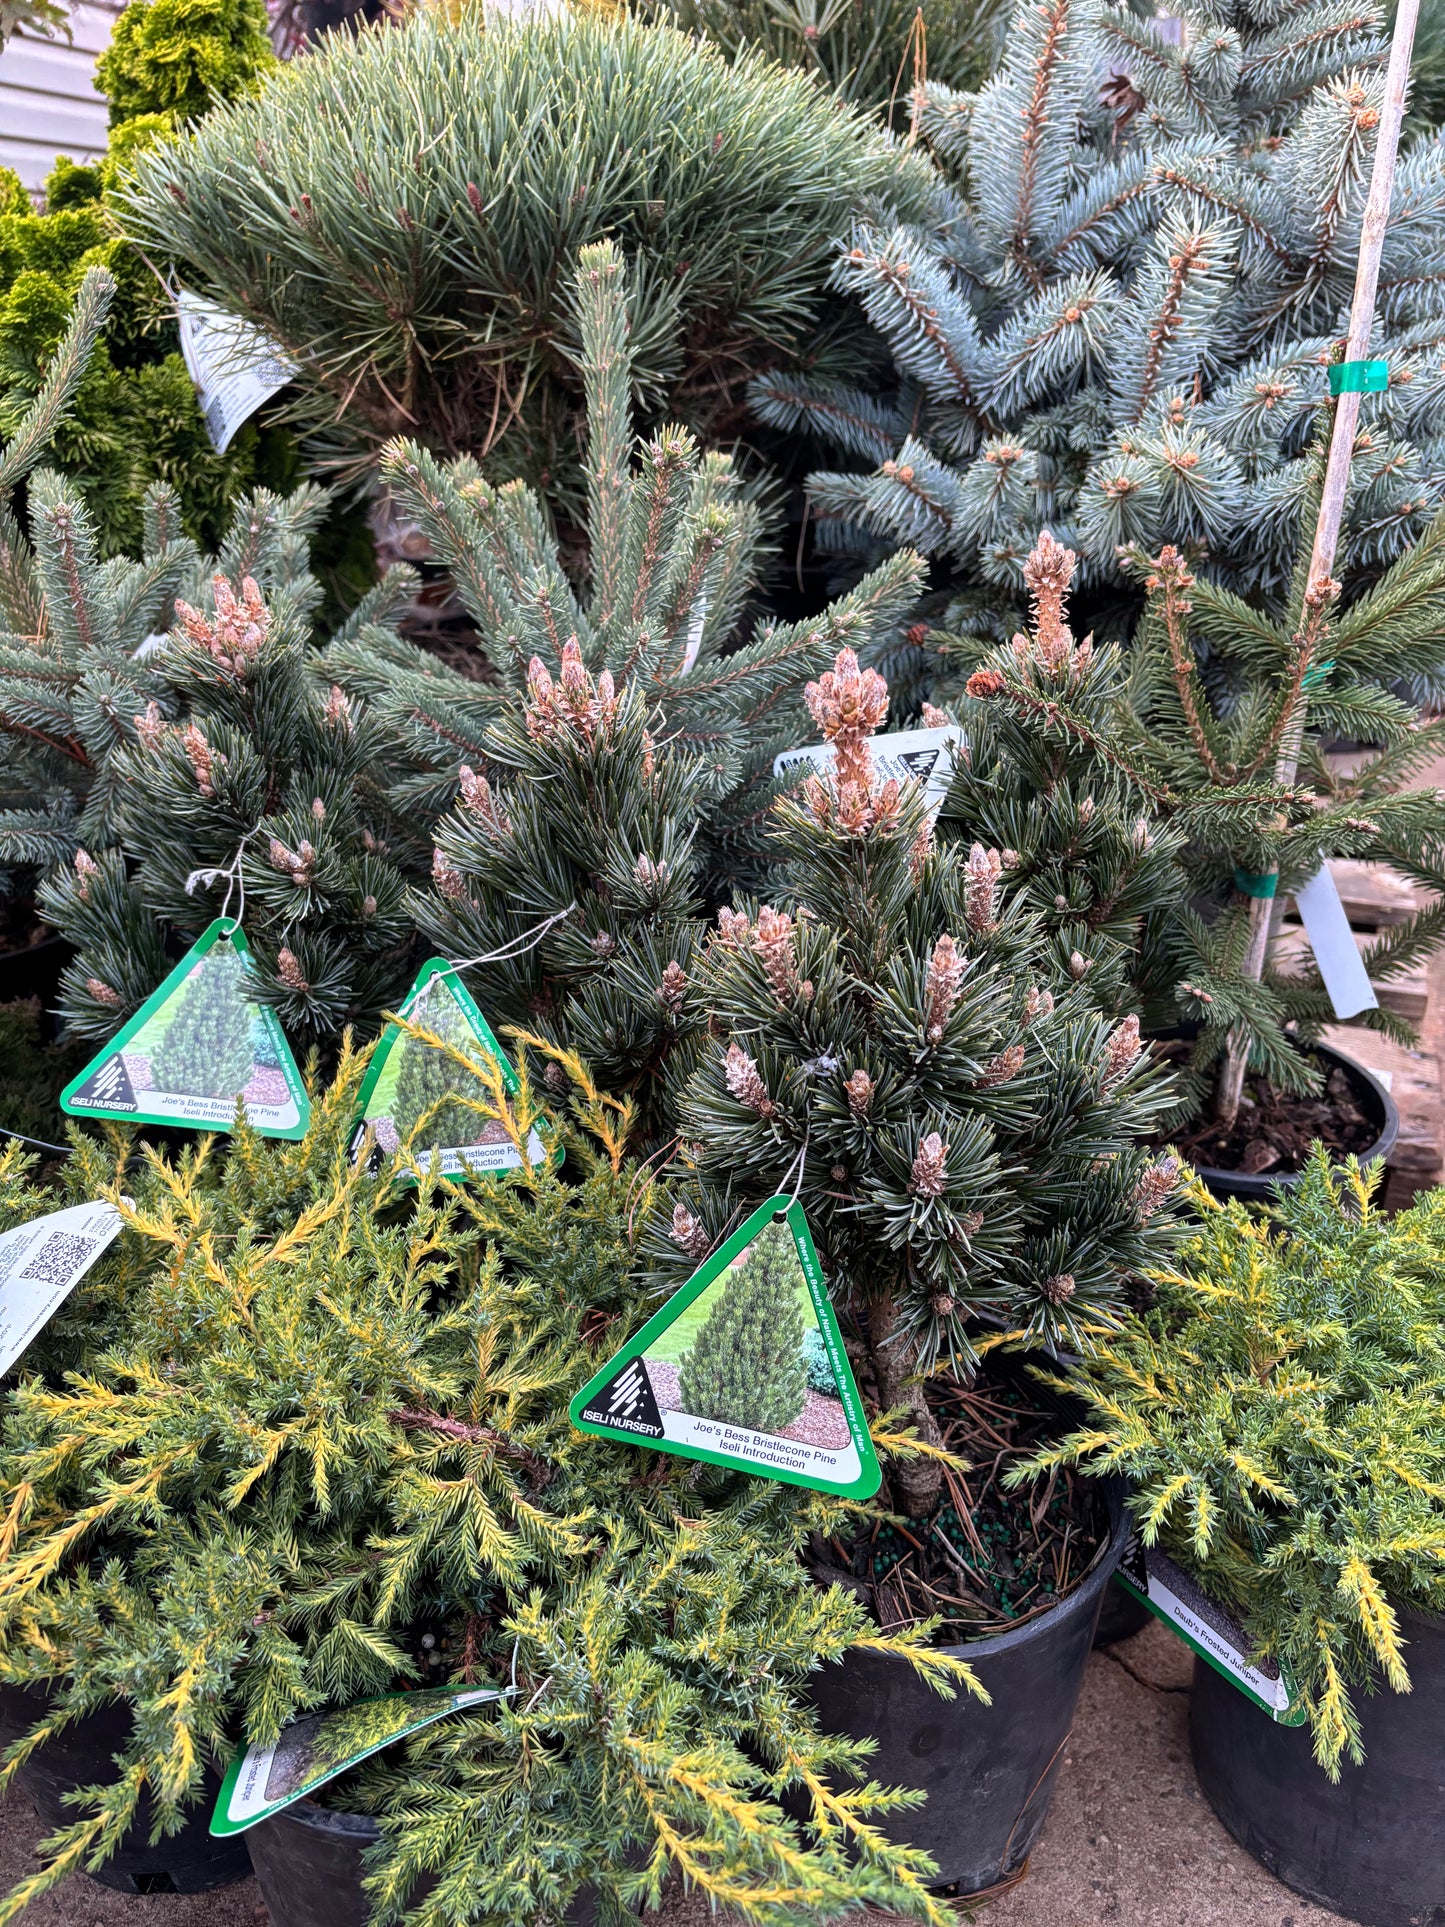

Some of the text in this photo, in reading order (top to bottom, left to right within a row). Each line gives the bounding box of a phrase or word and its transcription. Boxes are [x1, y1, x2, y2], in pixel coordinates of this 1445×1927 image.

[890, 759, 905, 778] Joe's
[453, 986, 466, 1007] Where
[463, 1005, 473, 1016] the
[506, 1079, 516, 1091] The
[279, 1050, 287, 1062] The
[283, 1062, 295, 1085] Artistry
[70, 1097, 137, 1111] ISELI NURSERY
[162, 1096, 185, 1106] Joe's
[187, 1098, 209, 1109] Bess
[260, 1107, 280, 1117] Pine
[183, 1107, 201, 1116] Iseli
[463, 1148, 505, 1159] ristlecone
[797, 1236, 865, 1452] Where the Beauty of Nature Meets The Artistry of Man
[582, 1409, 662, 1437] ISELI NURSERY
[693, 1421, 837, 1465] Joe's Bess Bristlecone Pine
[719, 1439, 806, 1470] Iseli Introduction
[1174, 1606, 1260, 1685] Daub's Frosted Juniper
